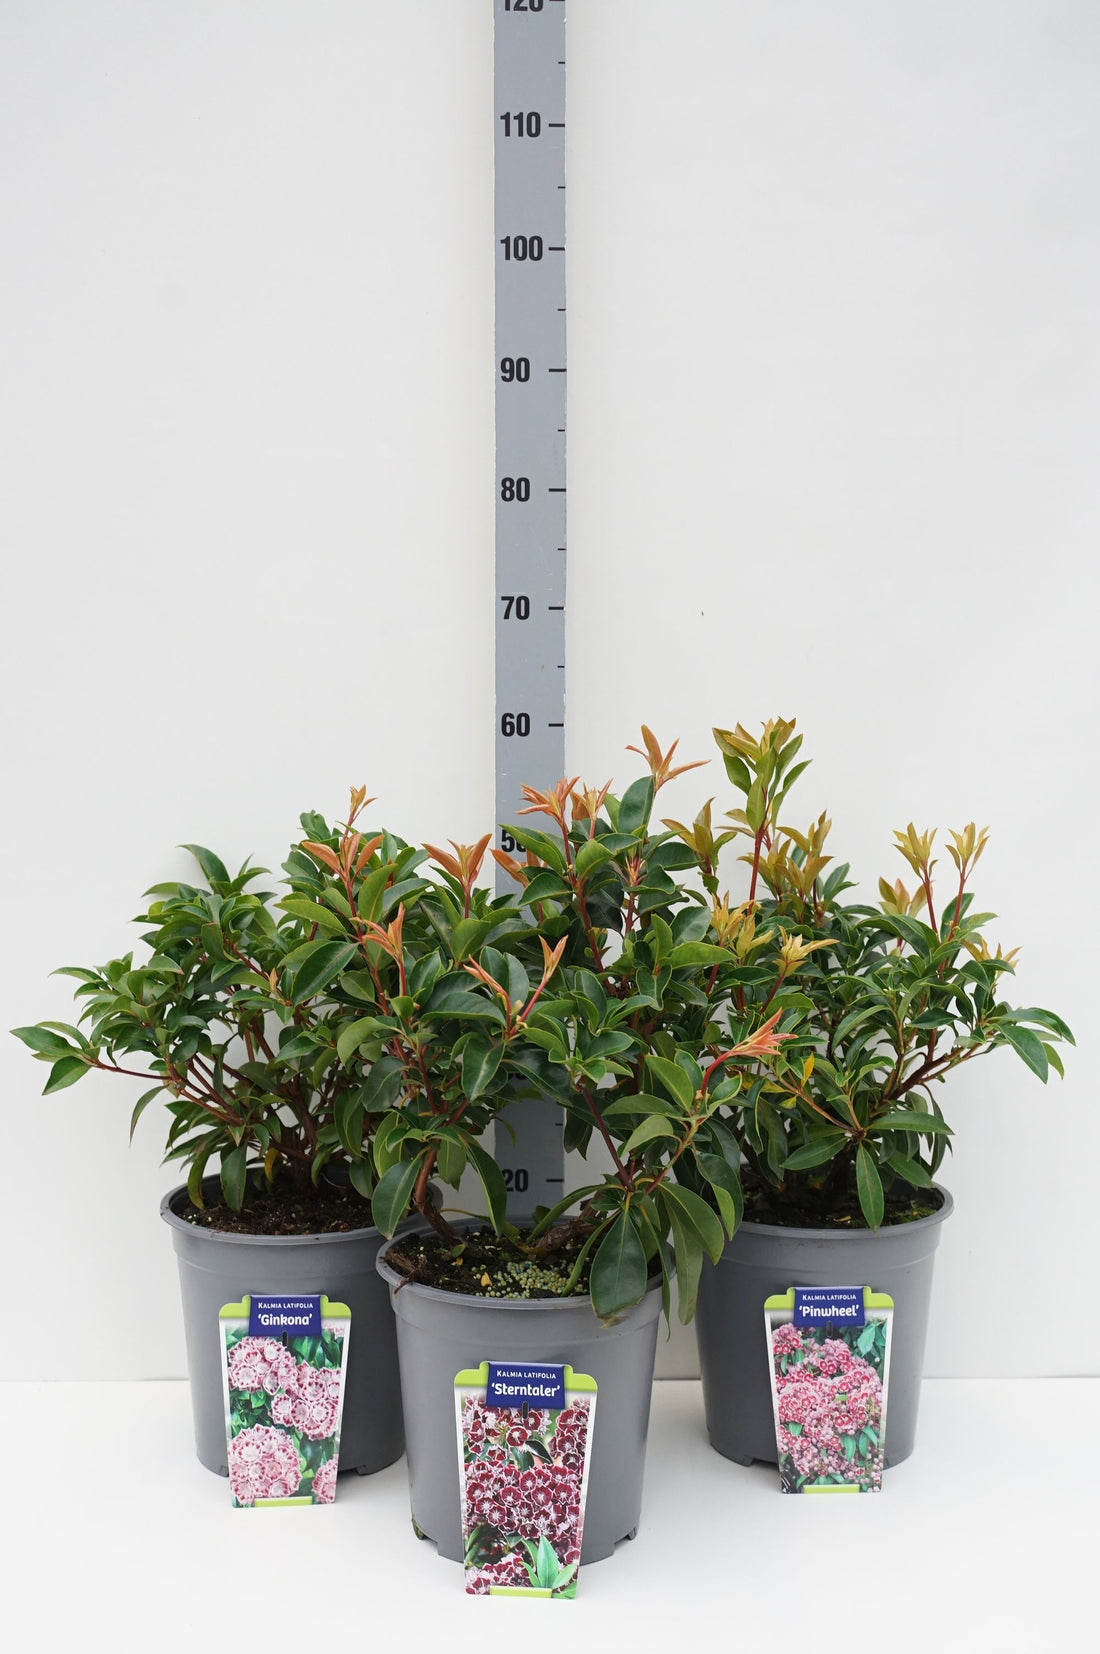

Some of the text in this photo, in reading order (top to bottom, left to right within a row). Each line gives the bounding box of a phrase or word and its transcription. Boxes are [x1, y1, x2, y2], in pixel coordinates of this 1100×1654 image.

[500, 112, 541, 137] 110
[500, 236, 543, 261] 100
[500, 358, 530, 382] 90
[501, 477, 530, 502] 80
[501, 596, 530, 620] 70
[501, 713, 530, 737] 60
[502, 1168, 529, 1192] 20
[497, 1370, 522, 1378] KALMIA
